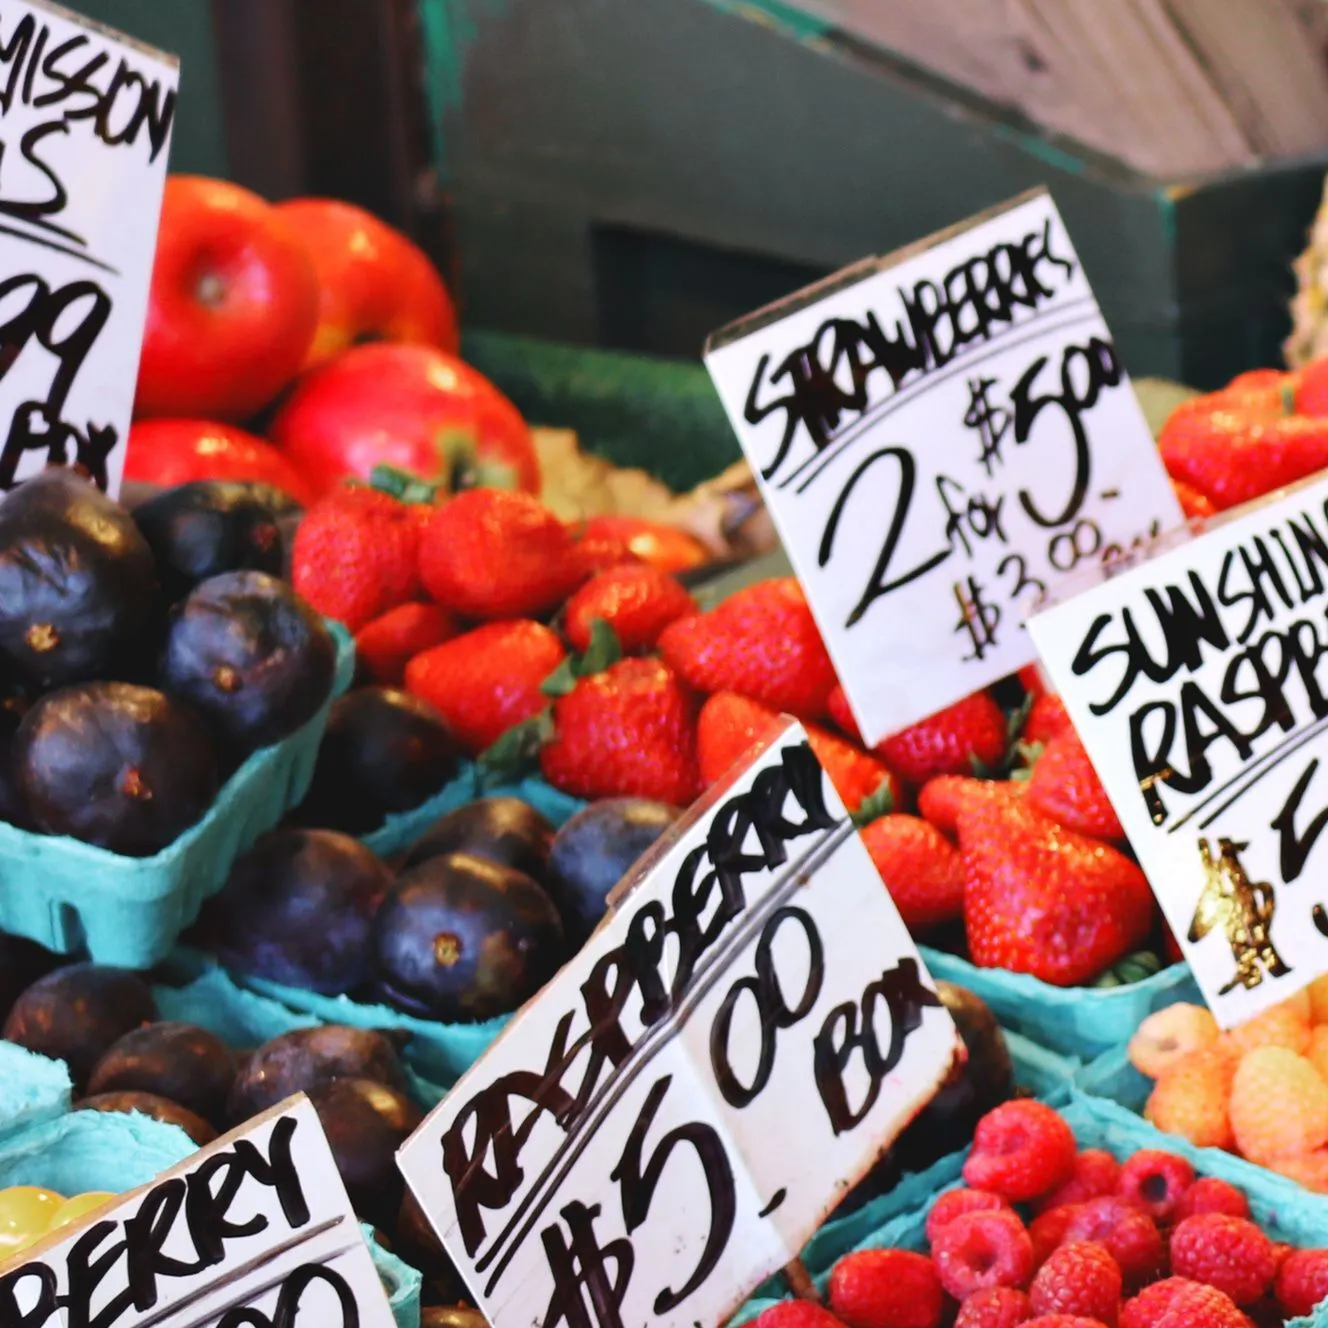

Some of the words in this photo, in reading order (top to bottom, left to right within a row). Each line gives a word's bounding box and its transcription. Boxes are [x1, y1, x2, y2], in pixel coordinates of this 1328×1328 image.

[817, 446, 955, 630] 2
[934, 474, 1010, 559] for
[441, 739, 842, 1259] RASPBERRY
[812, 956, 946, 1137] BOX
